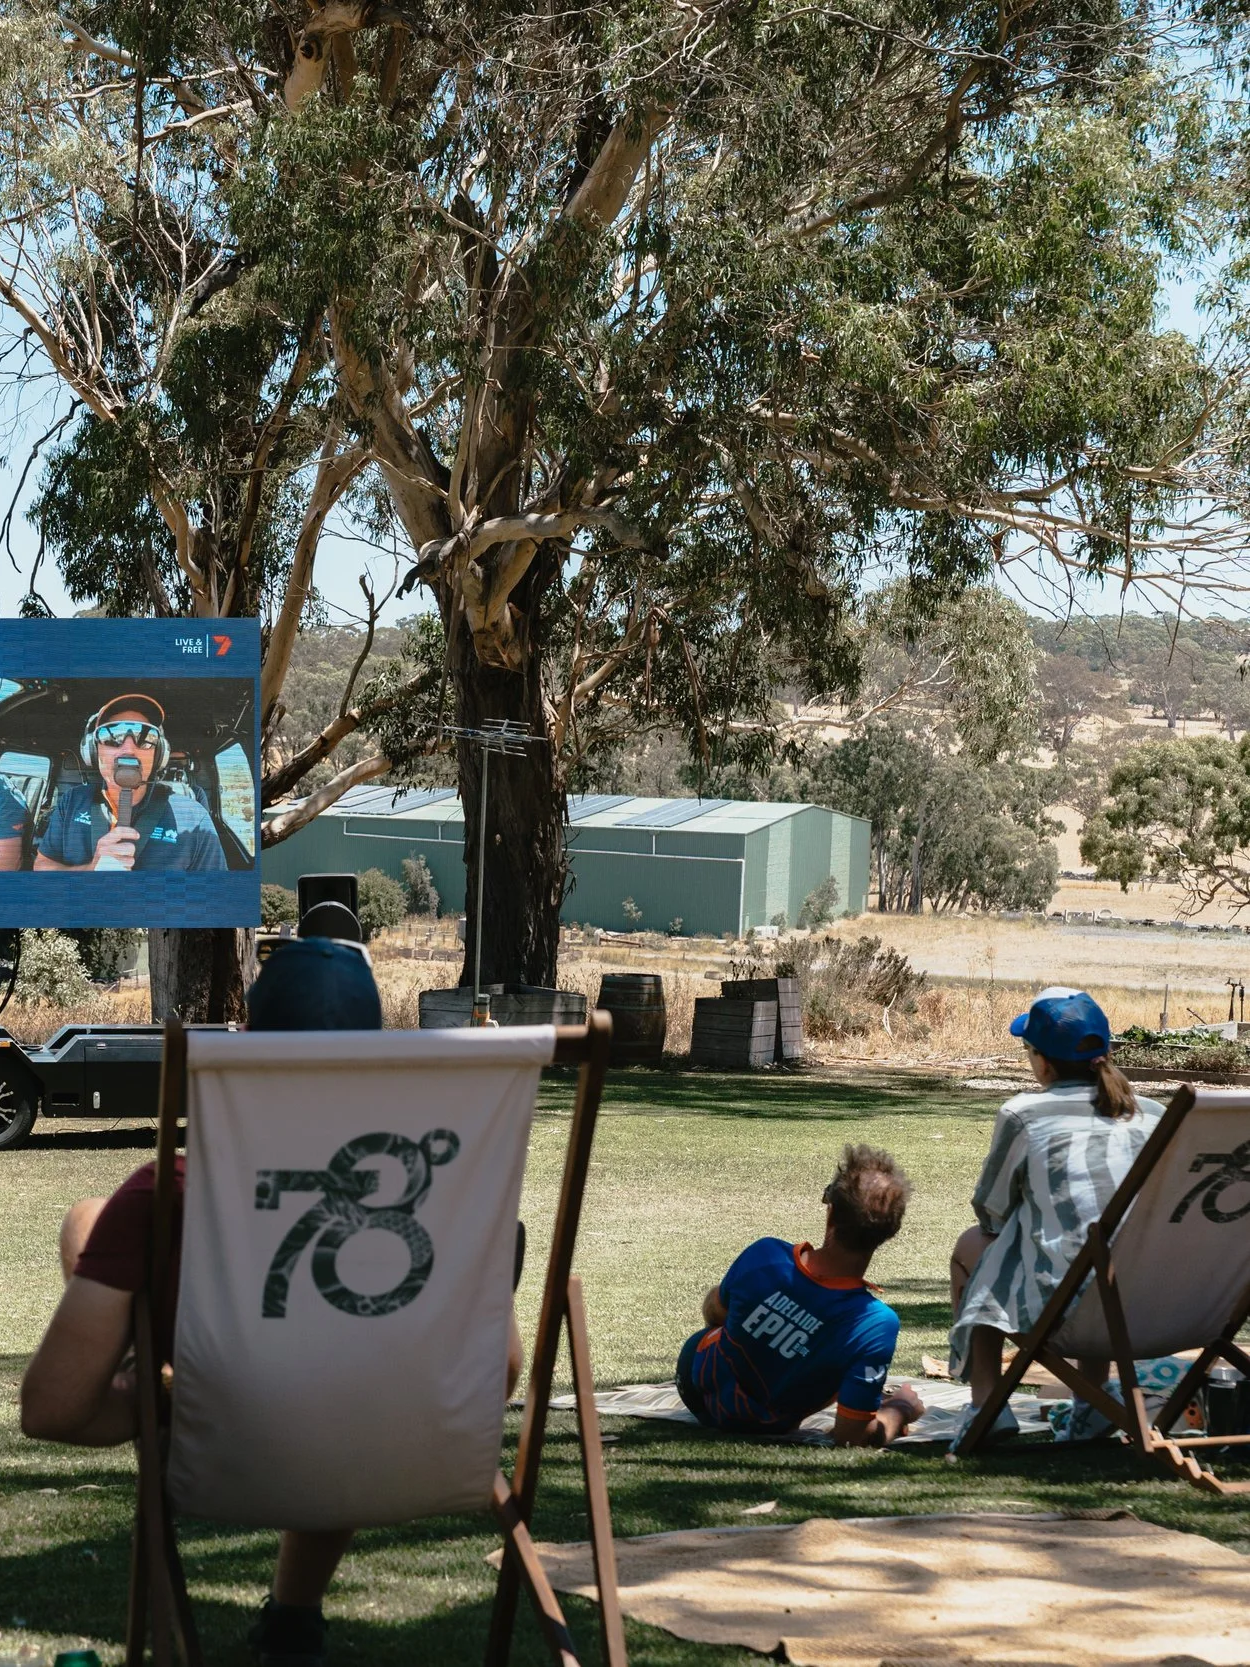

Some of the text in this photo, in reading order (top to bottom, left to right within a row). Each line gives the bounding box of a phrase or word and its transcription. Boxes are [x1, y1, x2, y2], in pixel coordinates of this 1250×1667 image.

[175, 638, 203, 646] LIVE &
[182, 646, 203, 654] FREE
[212, 635, 232, 656] 7
[763, 1290, 824, 1335] ADELAIDE
[741, 1303, 810, 1359] EPIC
